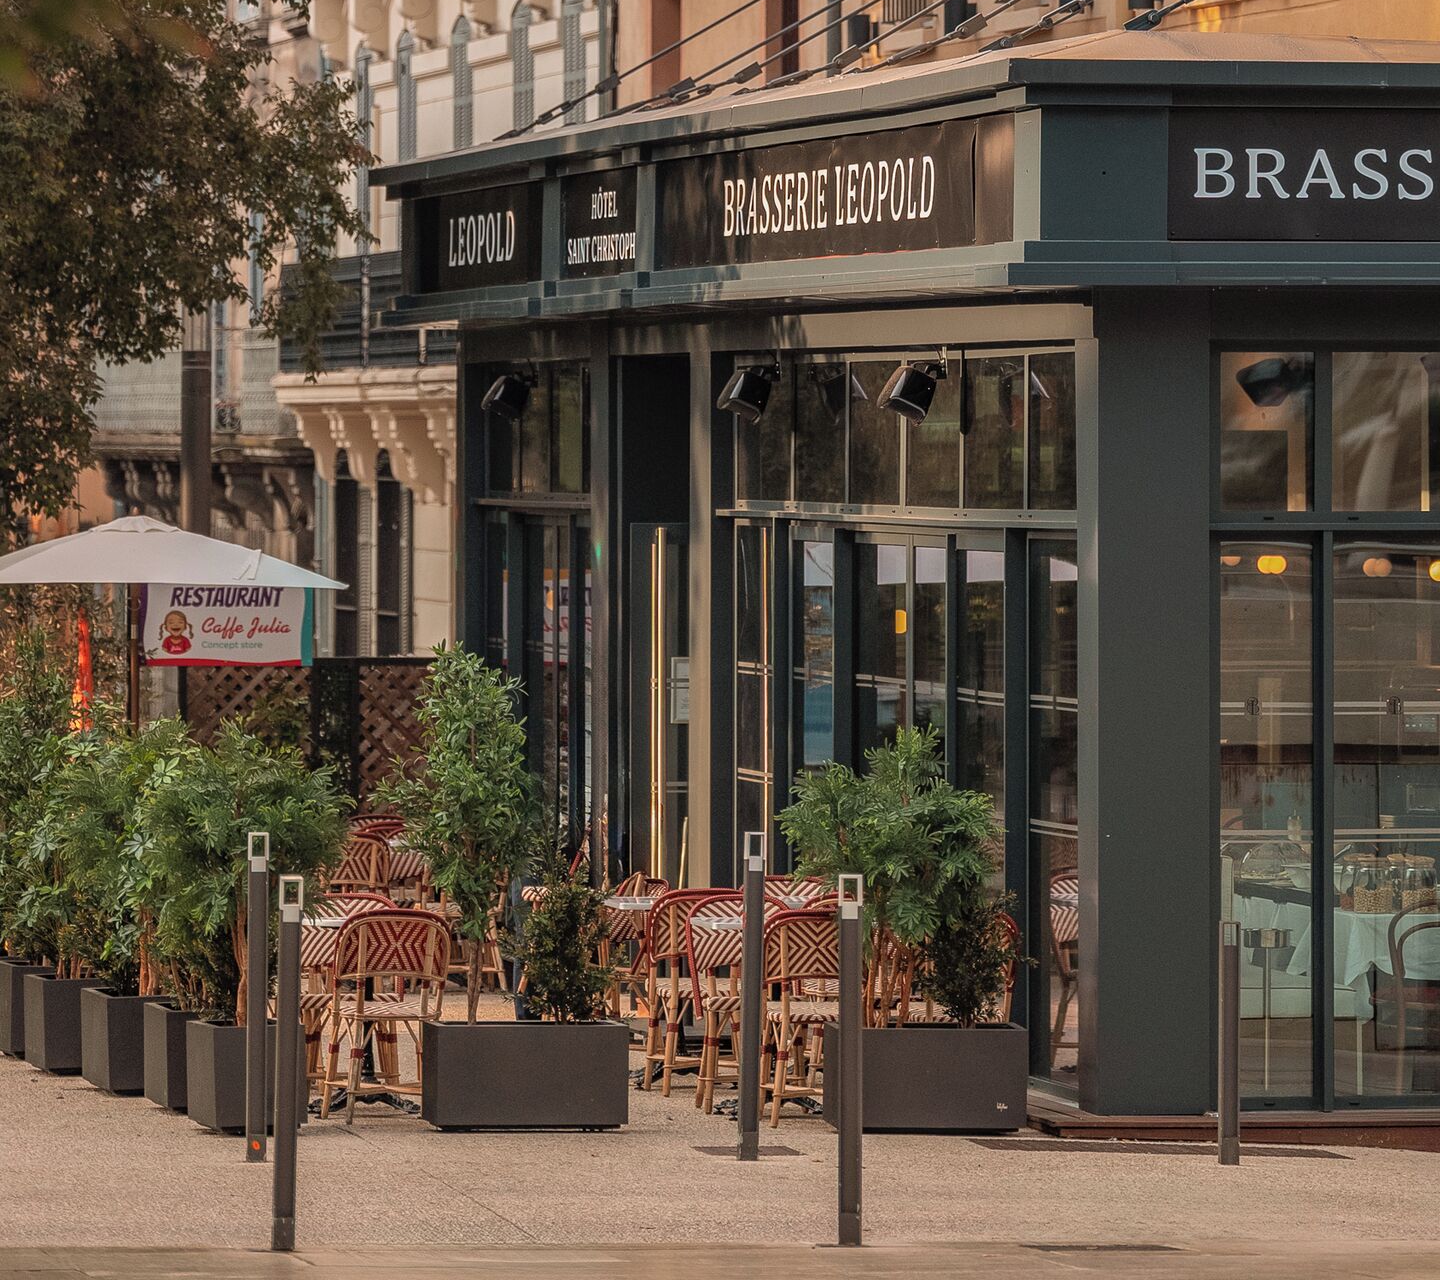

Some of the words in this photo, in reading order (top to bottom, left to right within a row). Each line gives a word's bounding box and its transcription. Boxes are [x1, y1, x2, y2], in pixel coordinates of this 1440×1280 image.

[590, 185, 619, 220] HÔTEL
[723, 168, 829, 238] BRASSERIE
[834, 155, 936, 227] LEOPOLD
[448, 210, 516, 268] LEOPOLD
[567, 236, 591, 265] SAINT
[169, 586, 284, 608] RESTAURANT
[201, 616, 244, 639] Caffe
[247, 616, 292, 639] Julia
[201, 640, 239, 650] Concept
[240, 641, 263, 649] store
